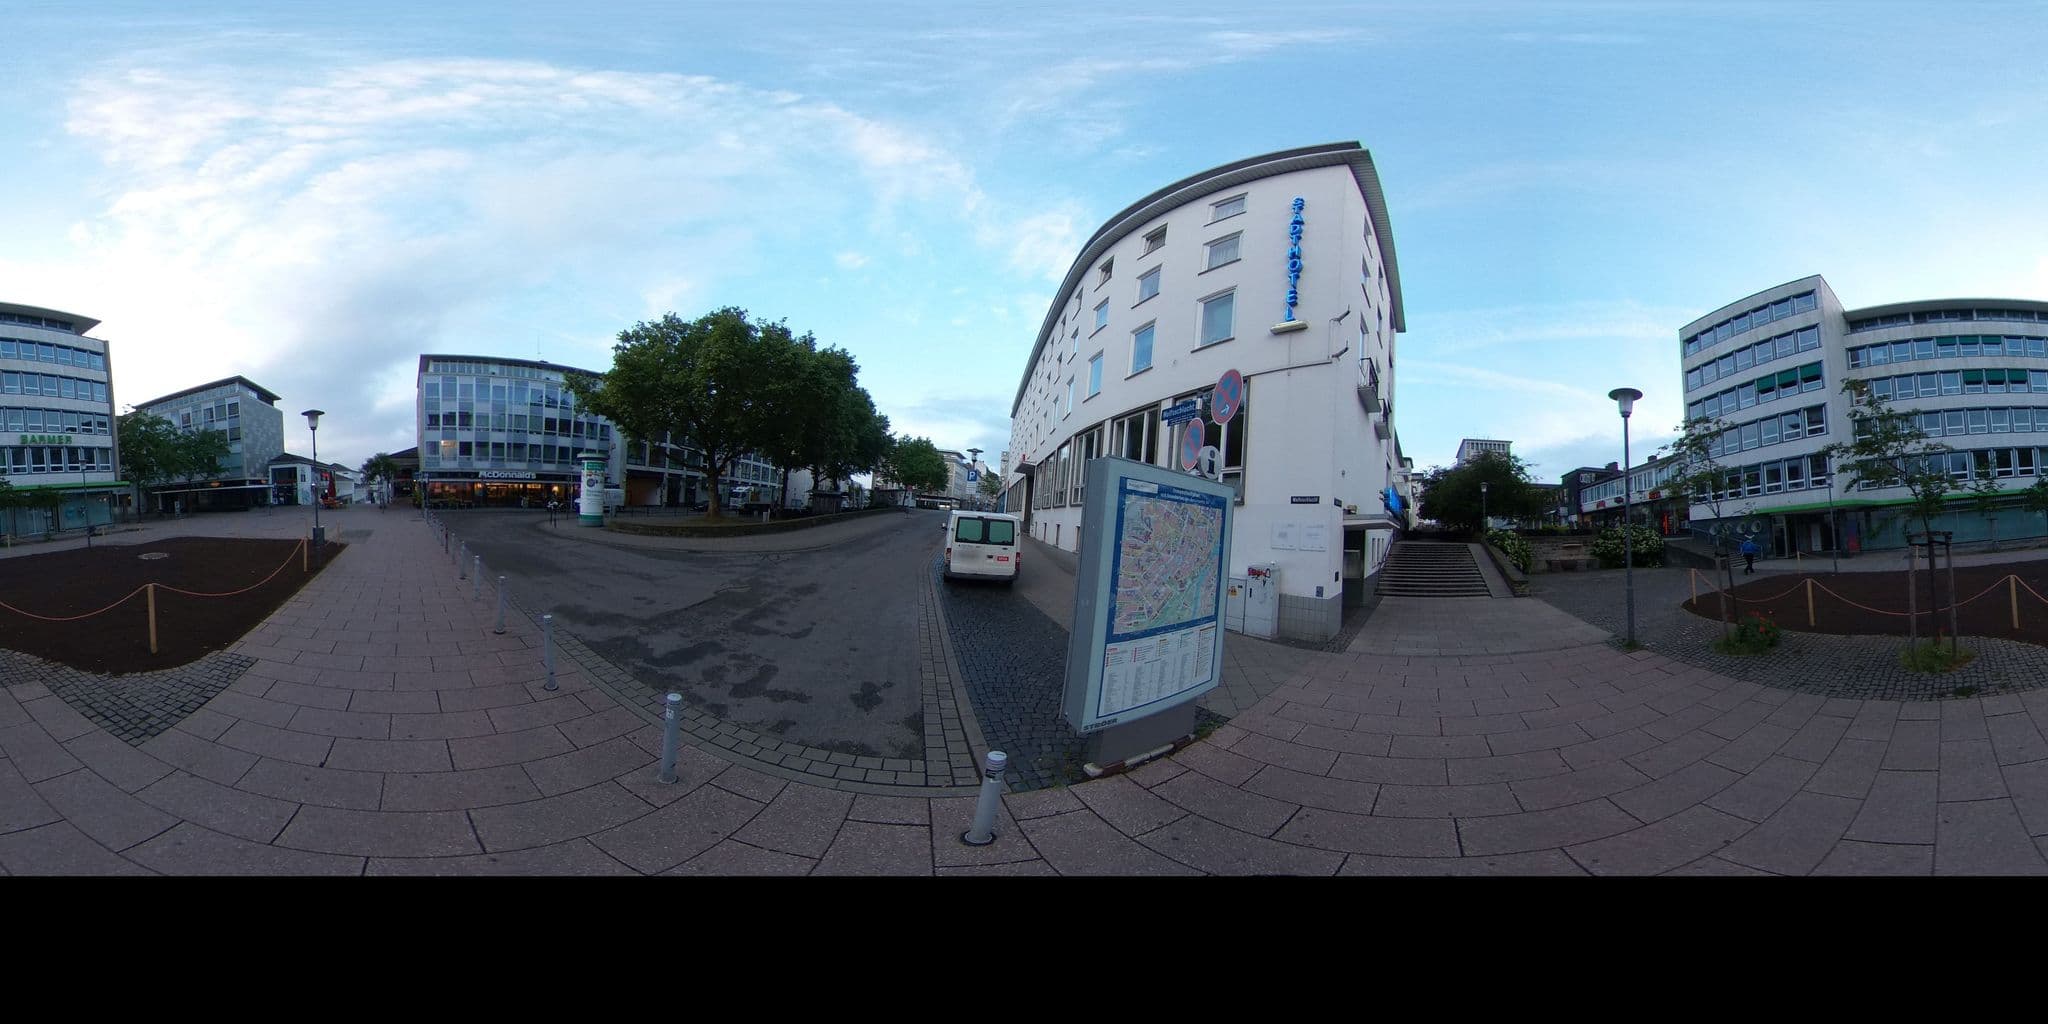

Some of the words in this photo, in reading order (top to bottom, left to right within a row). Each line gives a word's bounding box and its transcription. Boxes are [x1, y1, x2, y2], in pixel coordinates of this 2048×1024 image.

[1284, 197, 1305, 321] STADTHOTEL
[20, 434, 72, 445] BARMER
[969, 471, 976, 480] P
